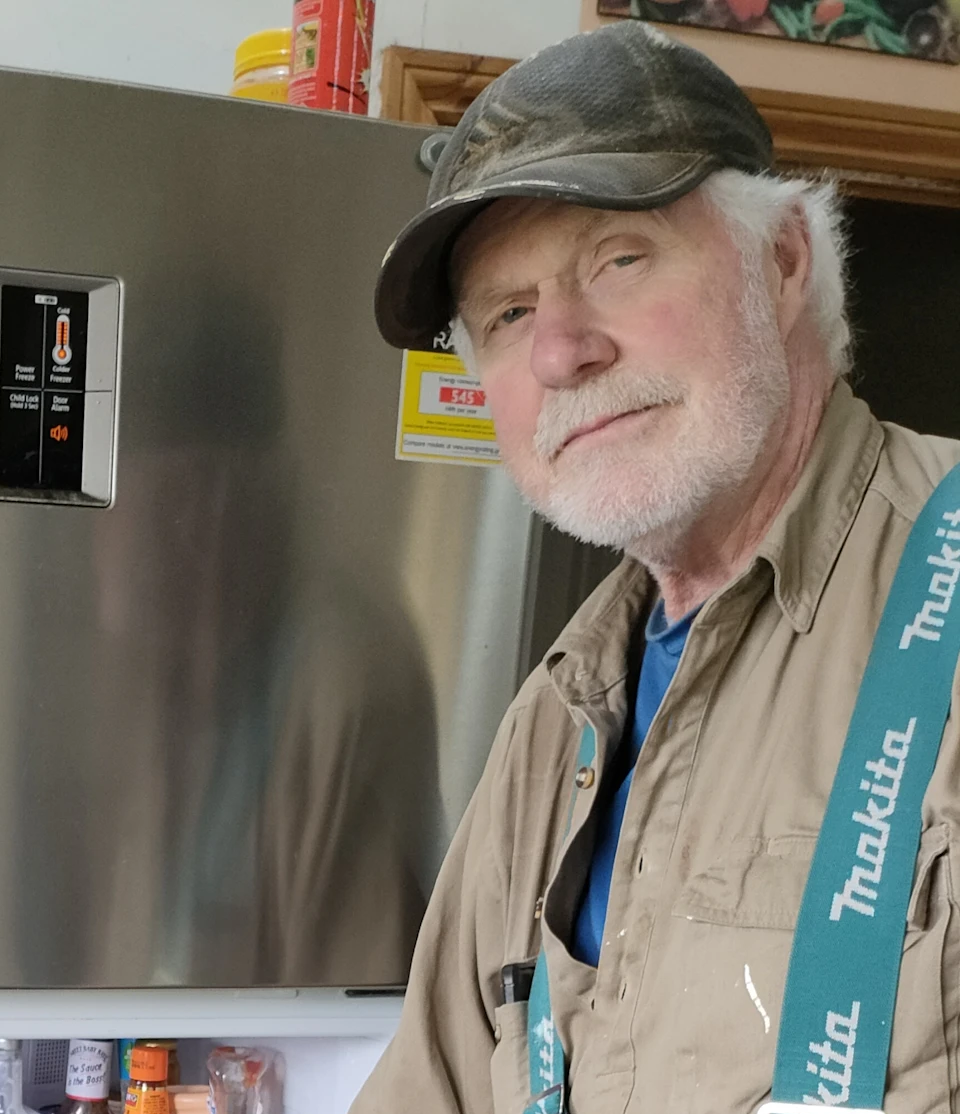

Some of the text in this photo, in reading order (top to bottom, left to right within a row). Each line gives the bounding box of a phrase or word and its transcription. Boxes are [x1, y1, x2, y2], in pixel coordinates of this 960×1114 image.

[15, 364, 36, 373] Power
[52, 365, 71, 373] Colder
[15, 372, 36, 381] Freeze
[50, 374, 73, 383] Freezer
[9, 393, 39, 403] Child Lock
[53, 395, 68, 404] Door
[451, 389, 476, 405] 545
[51, 403, 70, 412] Alarm
[898, 508, 960, 650] makit
[81, 1063, 103, 1073] Sauce
[73, 1076, 84, 1085] the
